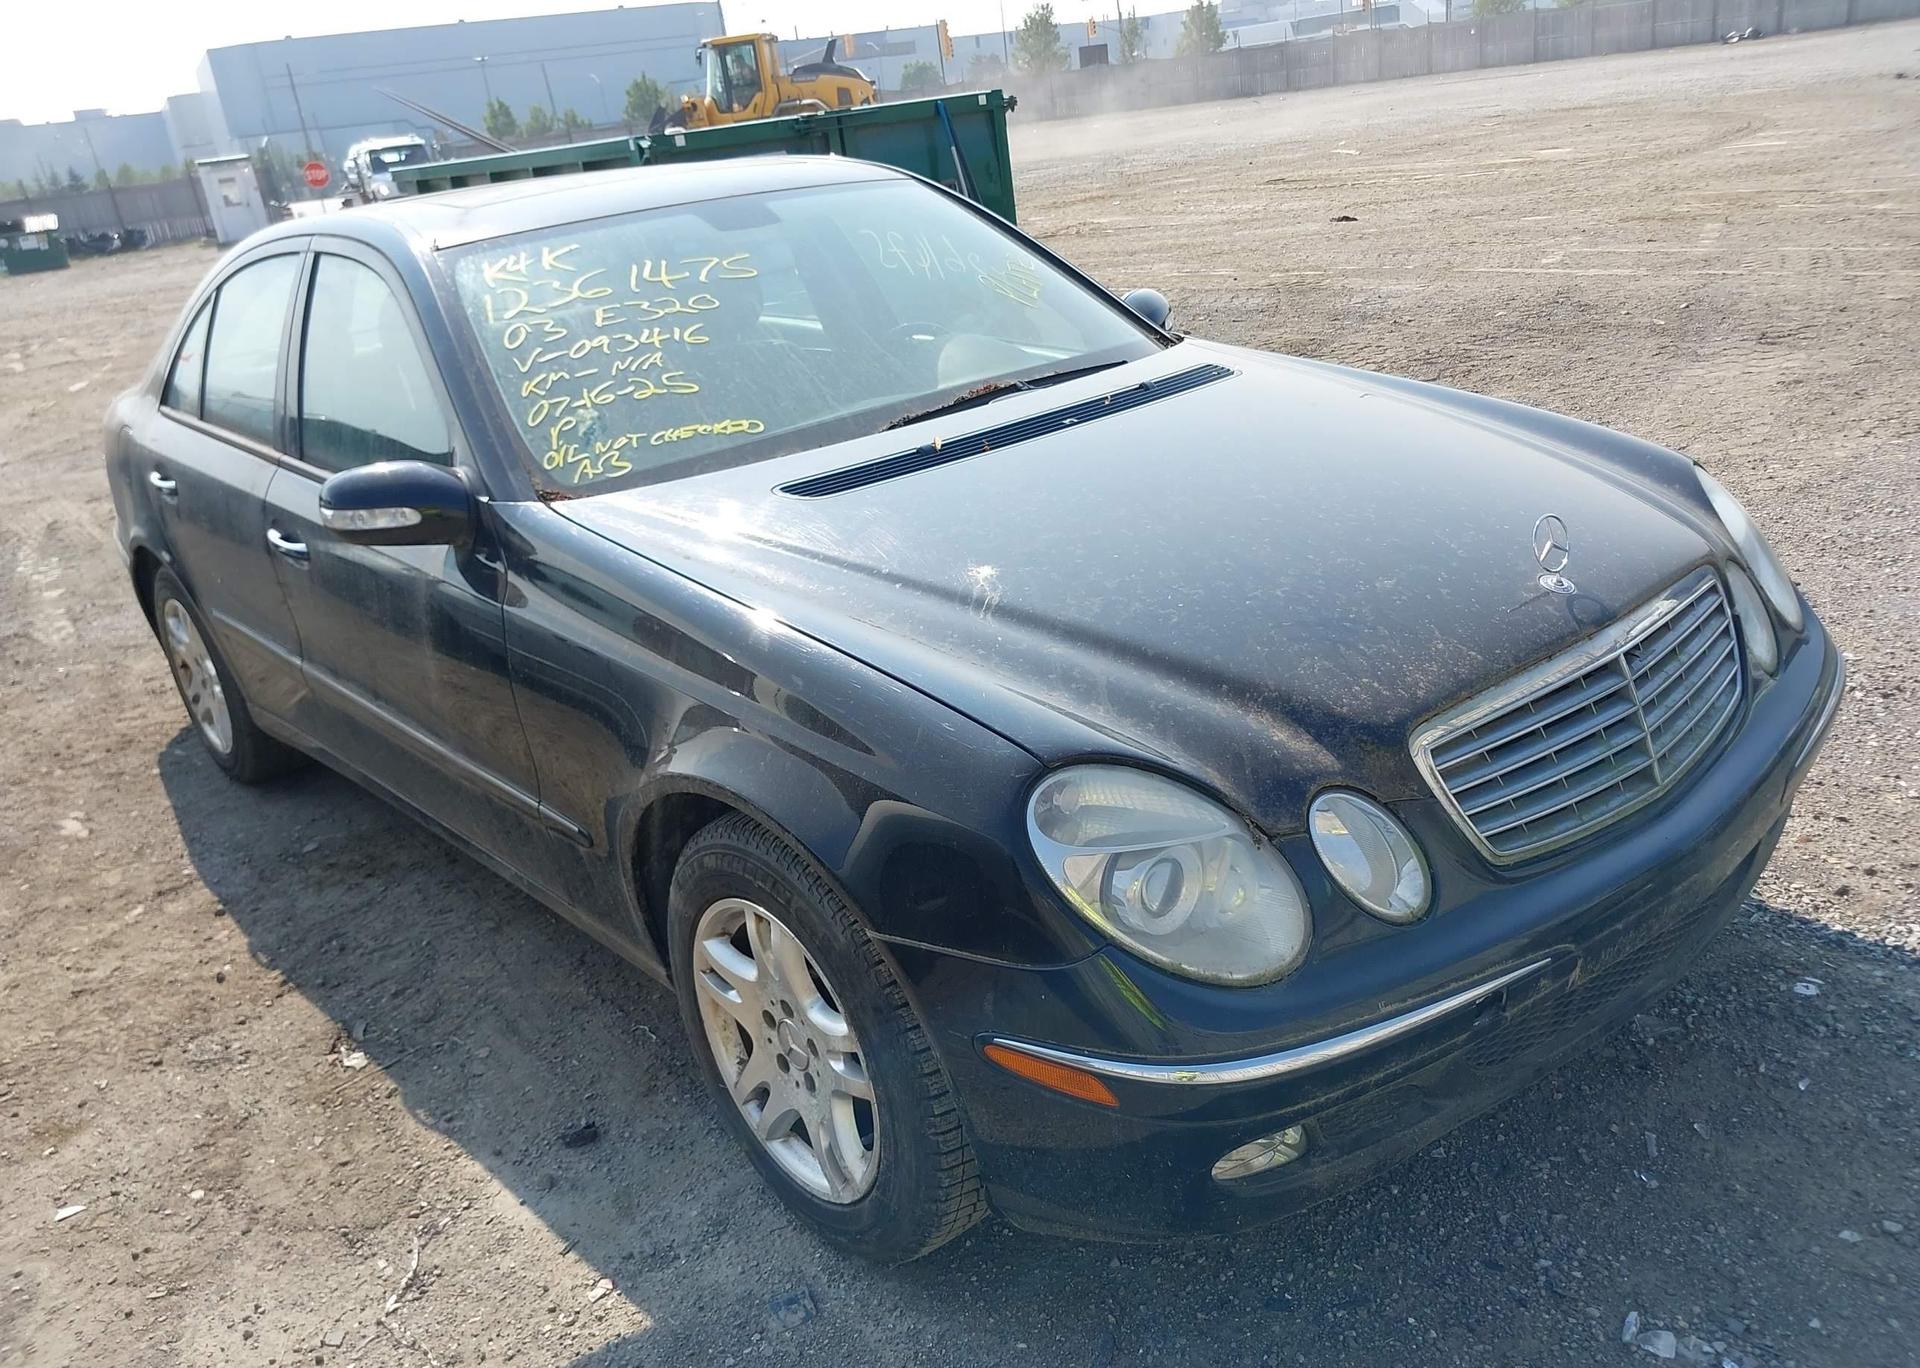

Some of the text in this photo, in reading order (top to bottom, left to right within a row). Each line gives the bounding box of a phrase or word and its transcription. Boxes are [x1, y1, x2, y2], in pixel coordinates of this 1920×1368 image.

[305, 168, 327, 181] STOP
[502, 293, 720, 350] 03 E320
[527, 371, 701, 428] 07-16-25
[596, 432, 648, 455] NOT
